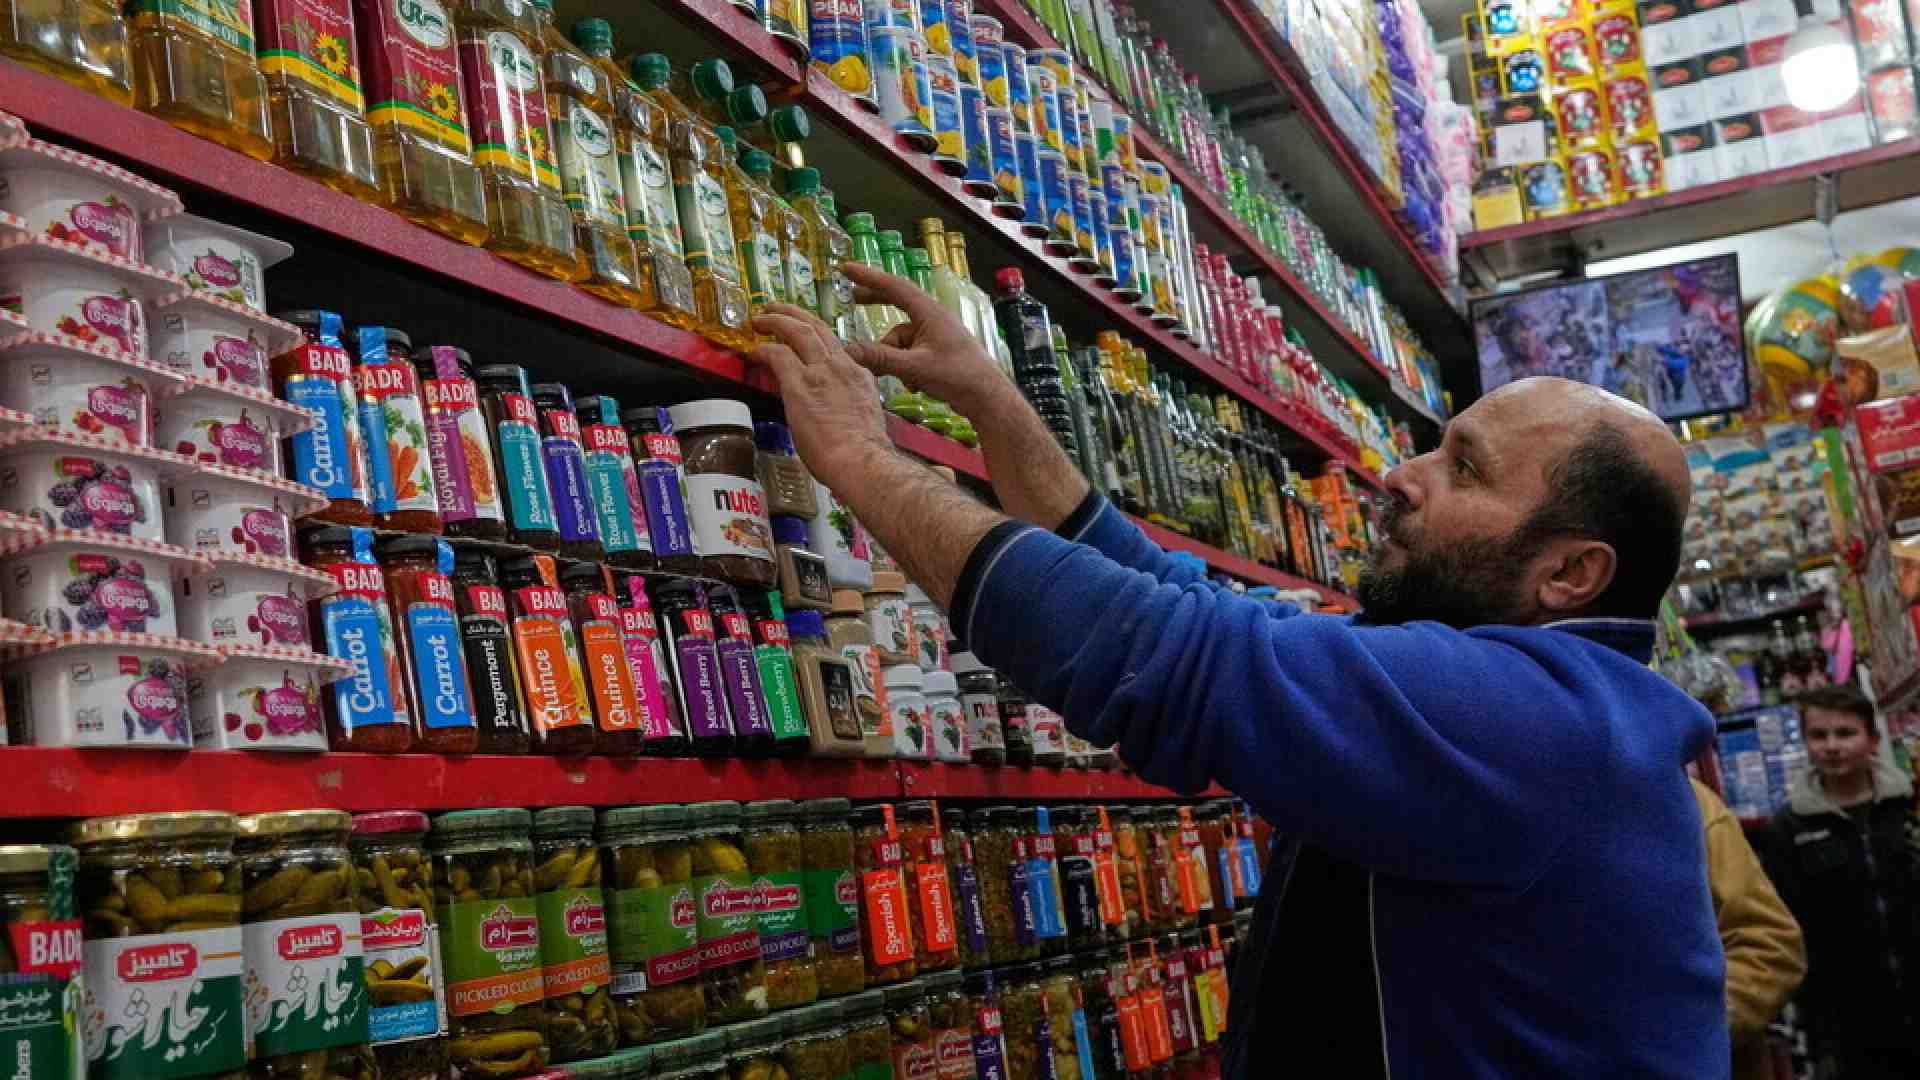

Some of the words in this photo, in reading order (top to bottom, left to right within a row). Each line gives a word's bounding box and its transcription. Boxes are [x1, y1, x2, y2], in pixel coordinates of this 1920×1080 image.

[599, 472, 615, 514] Flower
[342, 627, 378, 713] Carrot
[427, 634, 458, 715] Carrot
[535, 649, 562, 724] Quince
[602, 653, 627, 726] Quince
[456, 981, 508, 1004] PICKLED
